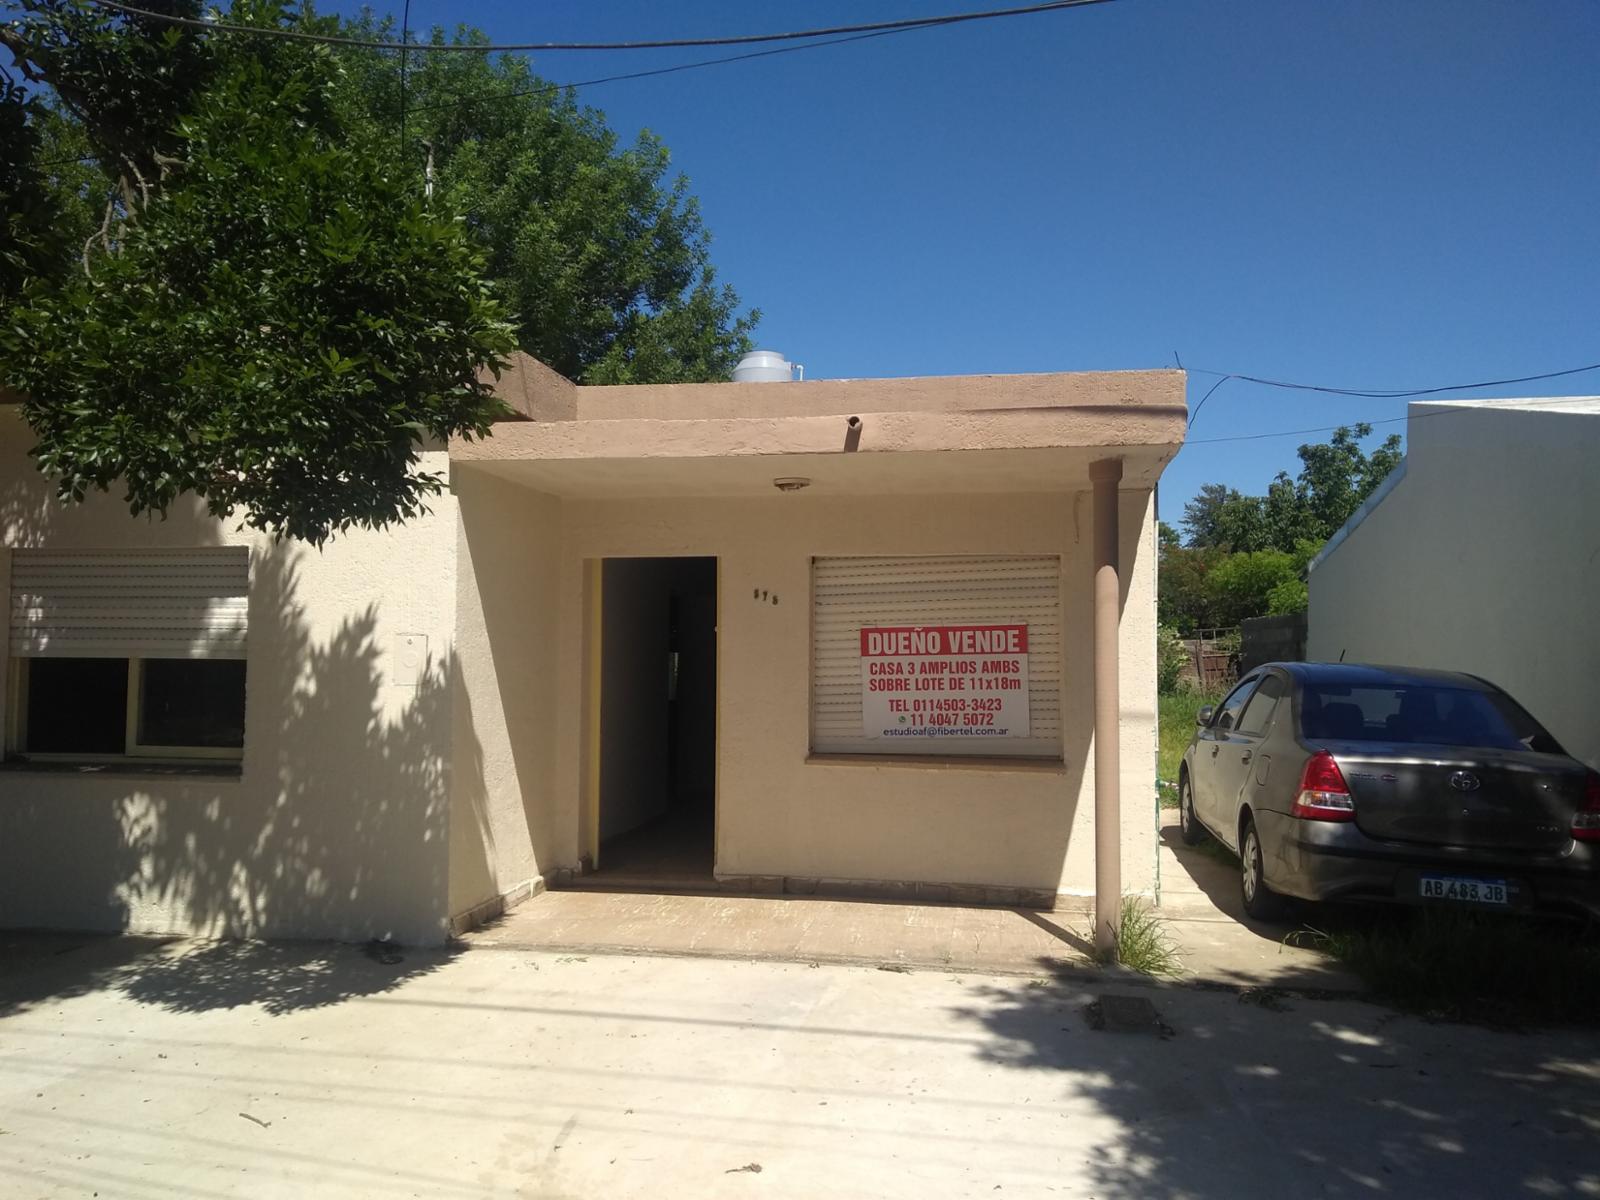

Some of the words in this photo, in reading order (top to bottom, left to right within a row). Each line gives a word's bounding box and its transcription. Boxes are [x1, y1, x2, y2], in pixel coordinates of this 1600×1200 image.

[868, 627, 941, 655] DUEÑO
[948, 630, 1020, 653] VENDE
[870, 662, 903, 675] CASA
[908, 662, 915, 675] 3
[920, 661, 976, 675] AMPLIOS
[982, 660, 1020, 674] AMBS
[870, 678, 910, 691] SOBRE
[915, 678, 944, 691] LOTE
[949, 678, 965, 690] DE
[970, 677, 1020, 690] 11x18m
[889, 699, 909, 712] TEL
[913, 699, 1002, 711] 0114503-3423
[911, 714, 923, 726] 11
[929, 713, 958, 726] 4047
[963, 713, 993, 725] 5072
[884, 727, 1008, 737] estudioaf@fibertel.com.ar
[1425, 881, 1443, 896] AB
